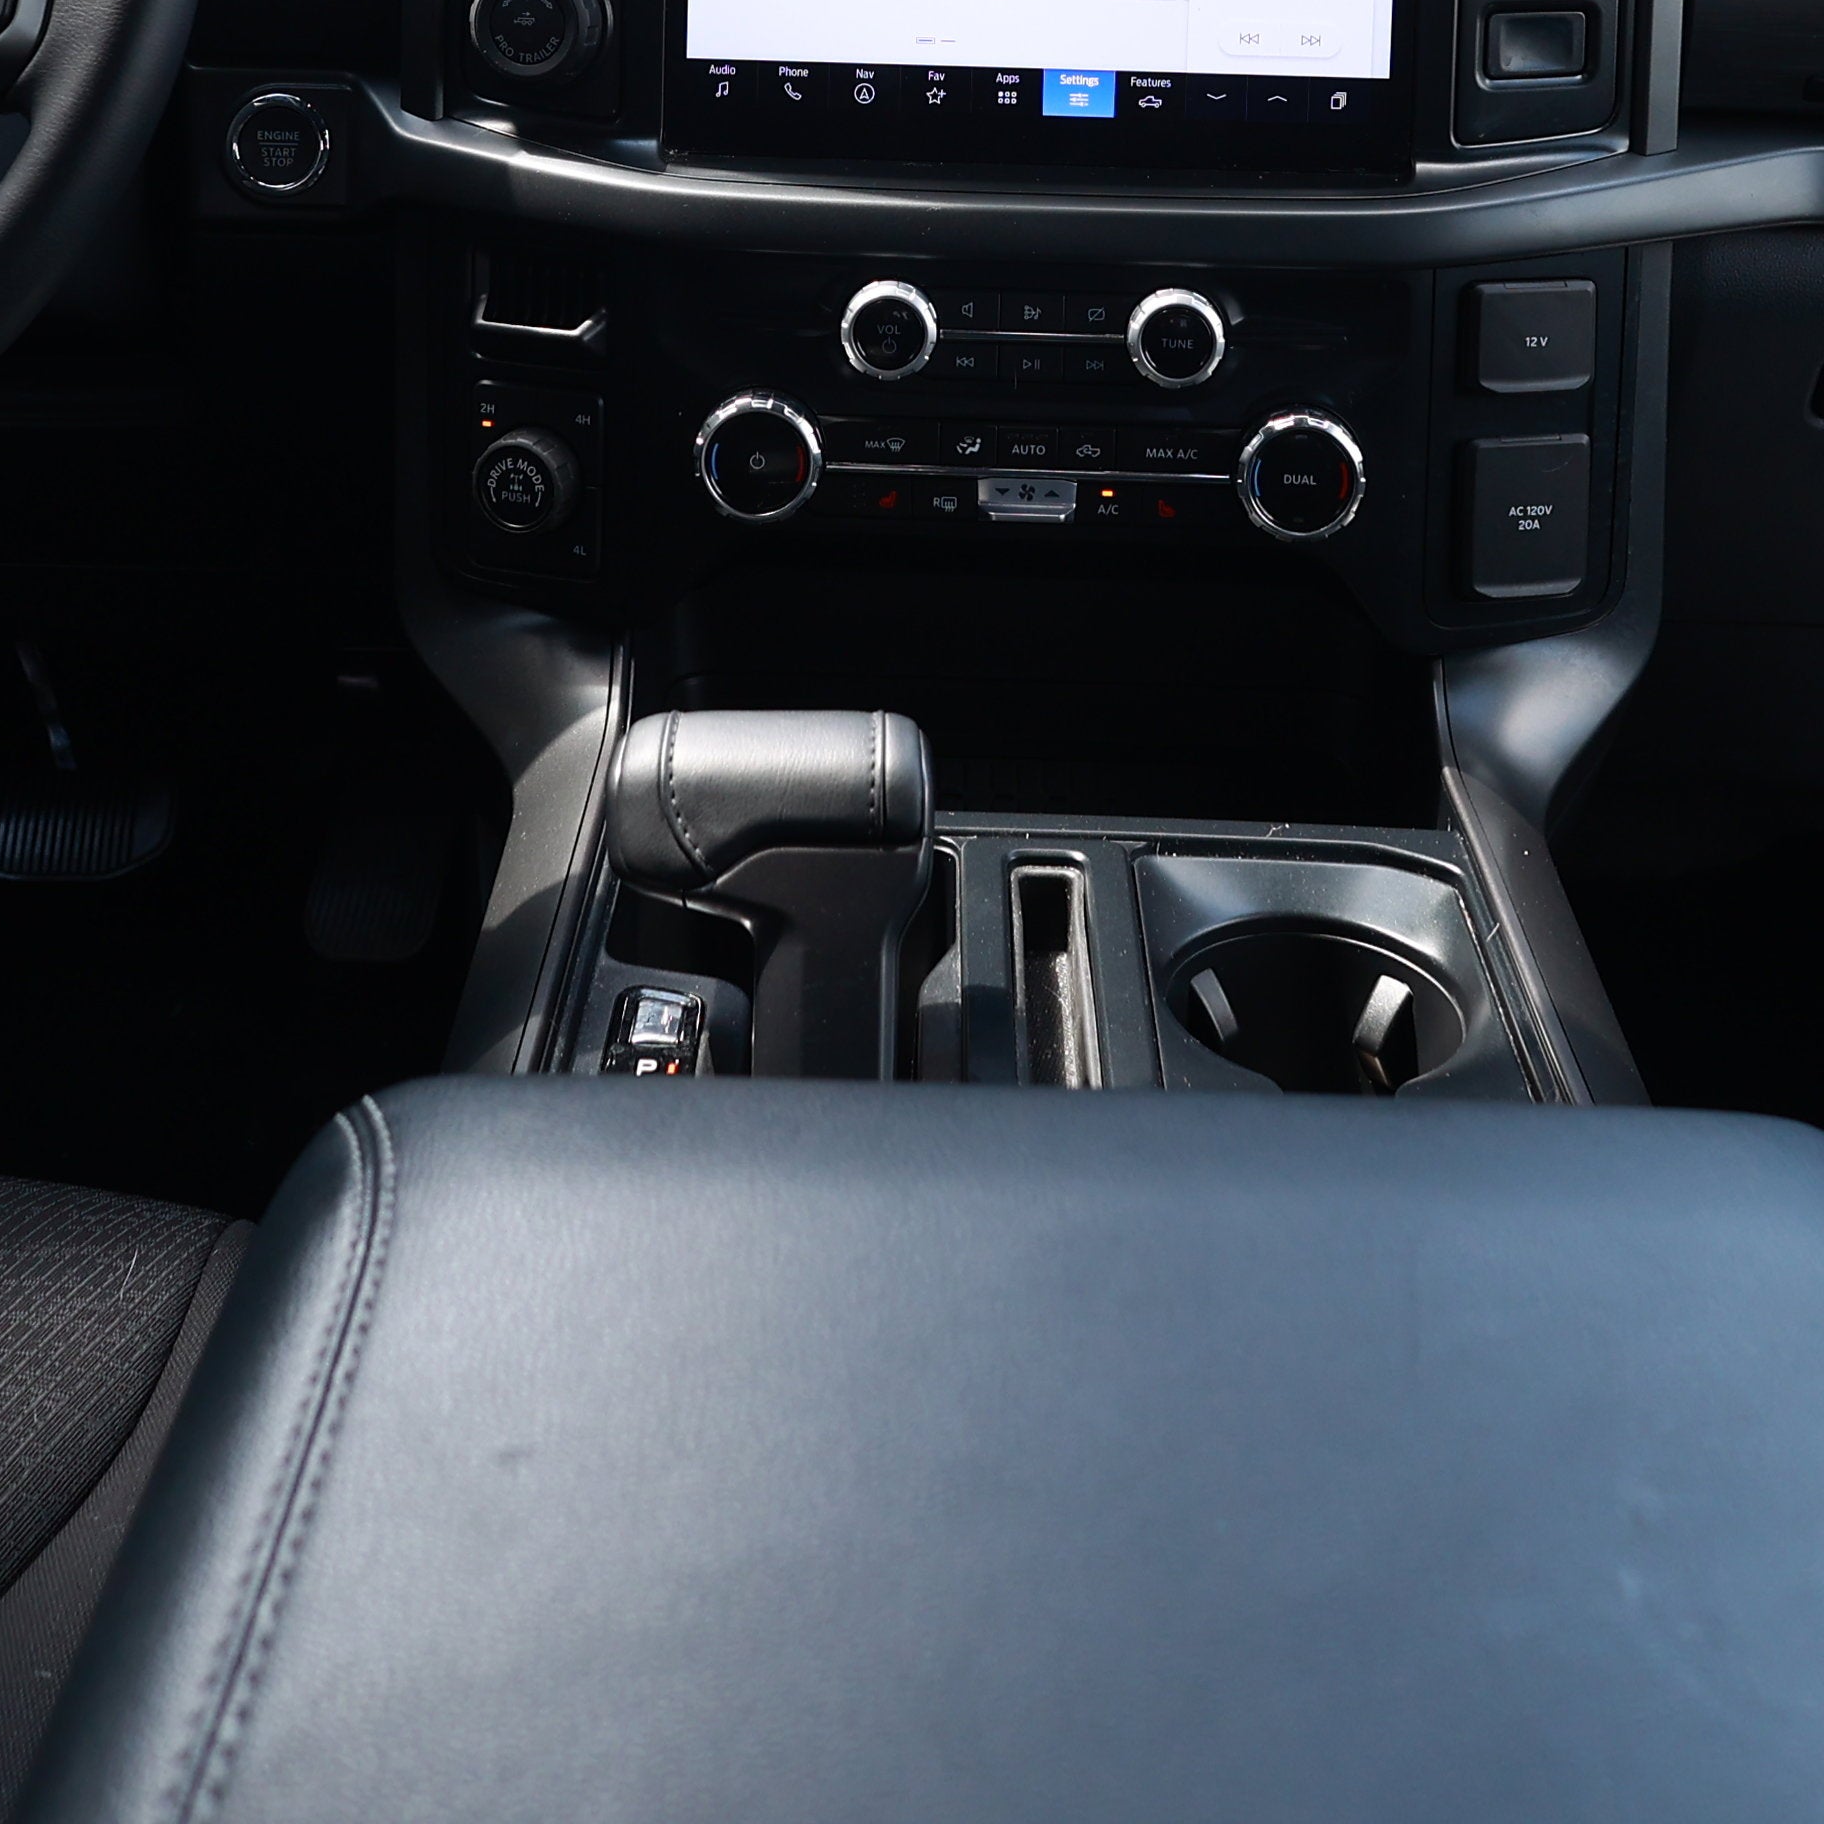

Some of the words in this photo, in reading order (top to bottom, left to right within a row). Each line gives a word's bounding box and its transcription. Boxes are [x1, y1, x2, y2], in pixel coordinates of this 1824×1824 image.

[494, 34, 514, 58] PRO
[518, 37, 561, 63] TRAILER
[708, 63, 736, 75] Audio
[778, 65, 809, 78] Phone
[855, 68, 875, 80] Nav
[928, 71, 946, 81] Fav
[995, 72, 1020, 85] Apps
[1060, 74, 1099, 88] Settings
[1130, 76, 1172, 88] Features
[256, 130, 299, 141] ENGINE
[261, 147, 296, 157] START
[263, 157, 294, 167] STOP
[877, 324, 901, 335] VOL
[1161, 337, 1194, 350] TUNE
[1525, 336, 1538, 347] 12
[1539, 336, 1549, 347] V
[480, 402, 495, 414] 2H
[575, 414, 591, 425] 4H
[864, 440, 886, 449] MAX
[1011, 444, 1046, 456] AUTO
[1145, 447, 1174, 459] MAX
[1176, 448, 1198, 460] A/C
[486, 457, 514, 489] DRIVE
[516, 459, 545, 493] MODE
[1283, 473, 1317, 486] DUAL
[501, 490, 531, 503] PUSH
[1097, 504, 1119, 515] A/C
[1508, 506, 1524, 517] AC
[1526, 504, 1553, 516] 120V
[1518, 519, 1540, 531] 20A
[572, 545, 587, 556] 4L
[636, 1057, 659, 1076] P
